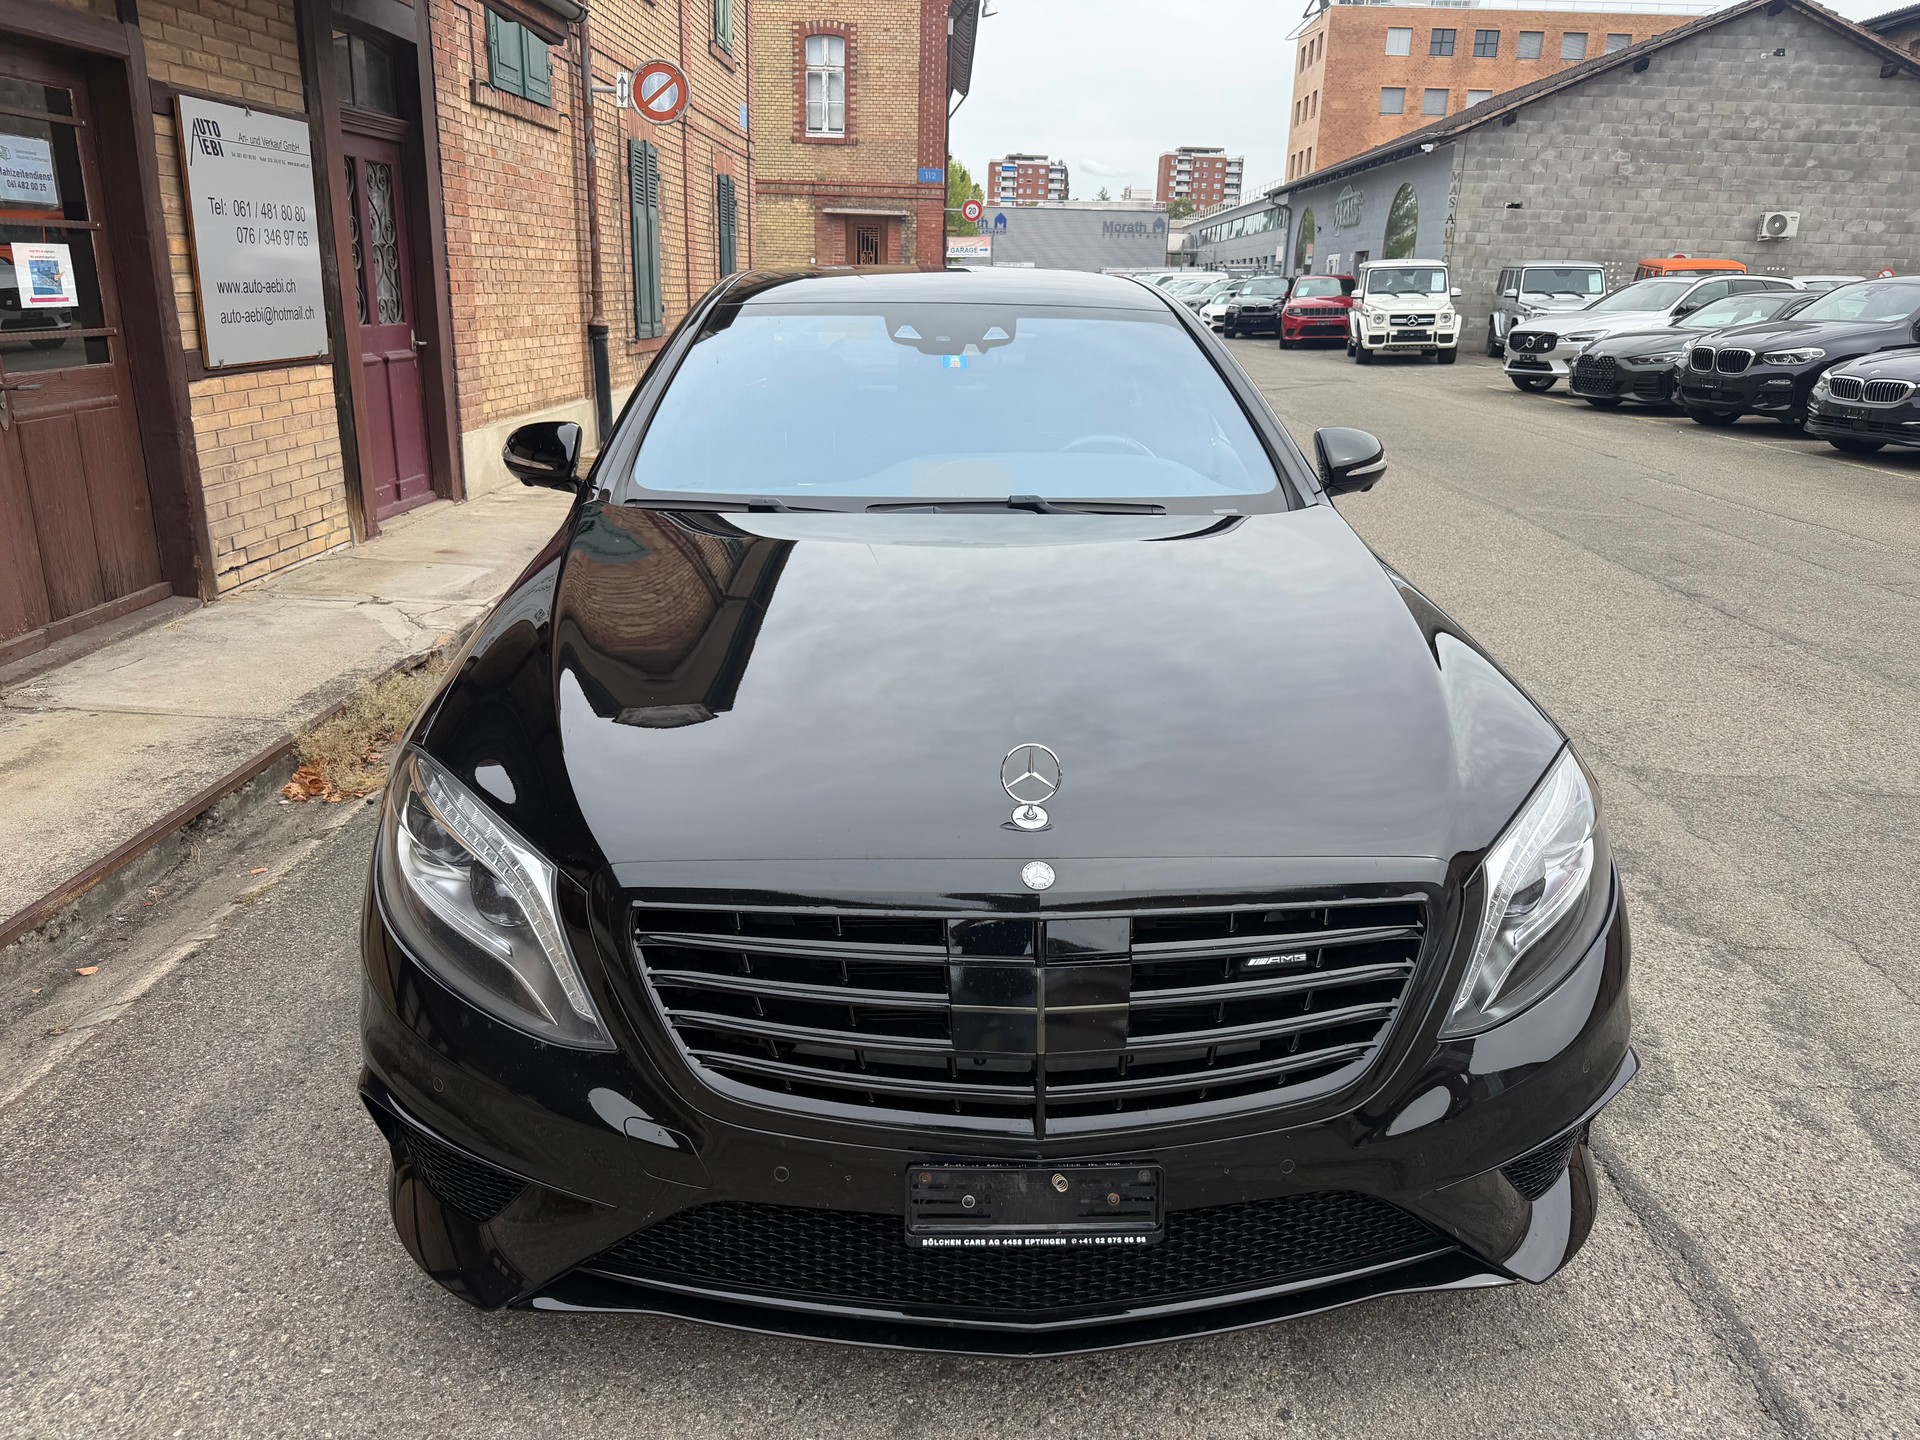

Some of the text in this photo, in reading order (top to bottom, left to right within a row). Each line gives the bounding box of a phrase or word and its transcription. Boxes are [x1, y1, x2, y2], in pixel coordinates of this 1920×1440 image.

[249, 135, 261, 146] und
[261, 137, 283, 150] Verkauf
[283, 141, 301, 153] GmbH
[925, 172, 936, 180] 112
[17, 181, 30, 190] 482
[31, 182, 38, 191] 00
[40, 183, 47, 192] 25
[208, 196, 228, 216] Tel:
[233, 199, 252, 218] 061
[261, 202, 278, 220] 481
[281, 204, 292, 221] 80
[294, 206, 306, 222] 80
[968, 206, 977, 215] 20
[1102, 220, 1147, 233] Morath
[236, 226, 256, 244] 076
[263, 228, 282, 246] 346
[283, 229, 294, 246] 97
[297, 230, 309, 247] 65
[216, 278, 296, 294] www.auto-aebi.ch
[220, 305, 315, 326] auto-aebi@hotmail.ch
[1266, 953, 1307, 965] AMG
[964, 1238, 986, 1246] CARS
[988, 1238, 1000, 1246] AG
[1024, 1238, 1067, 1246] EPTINGEN
